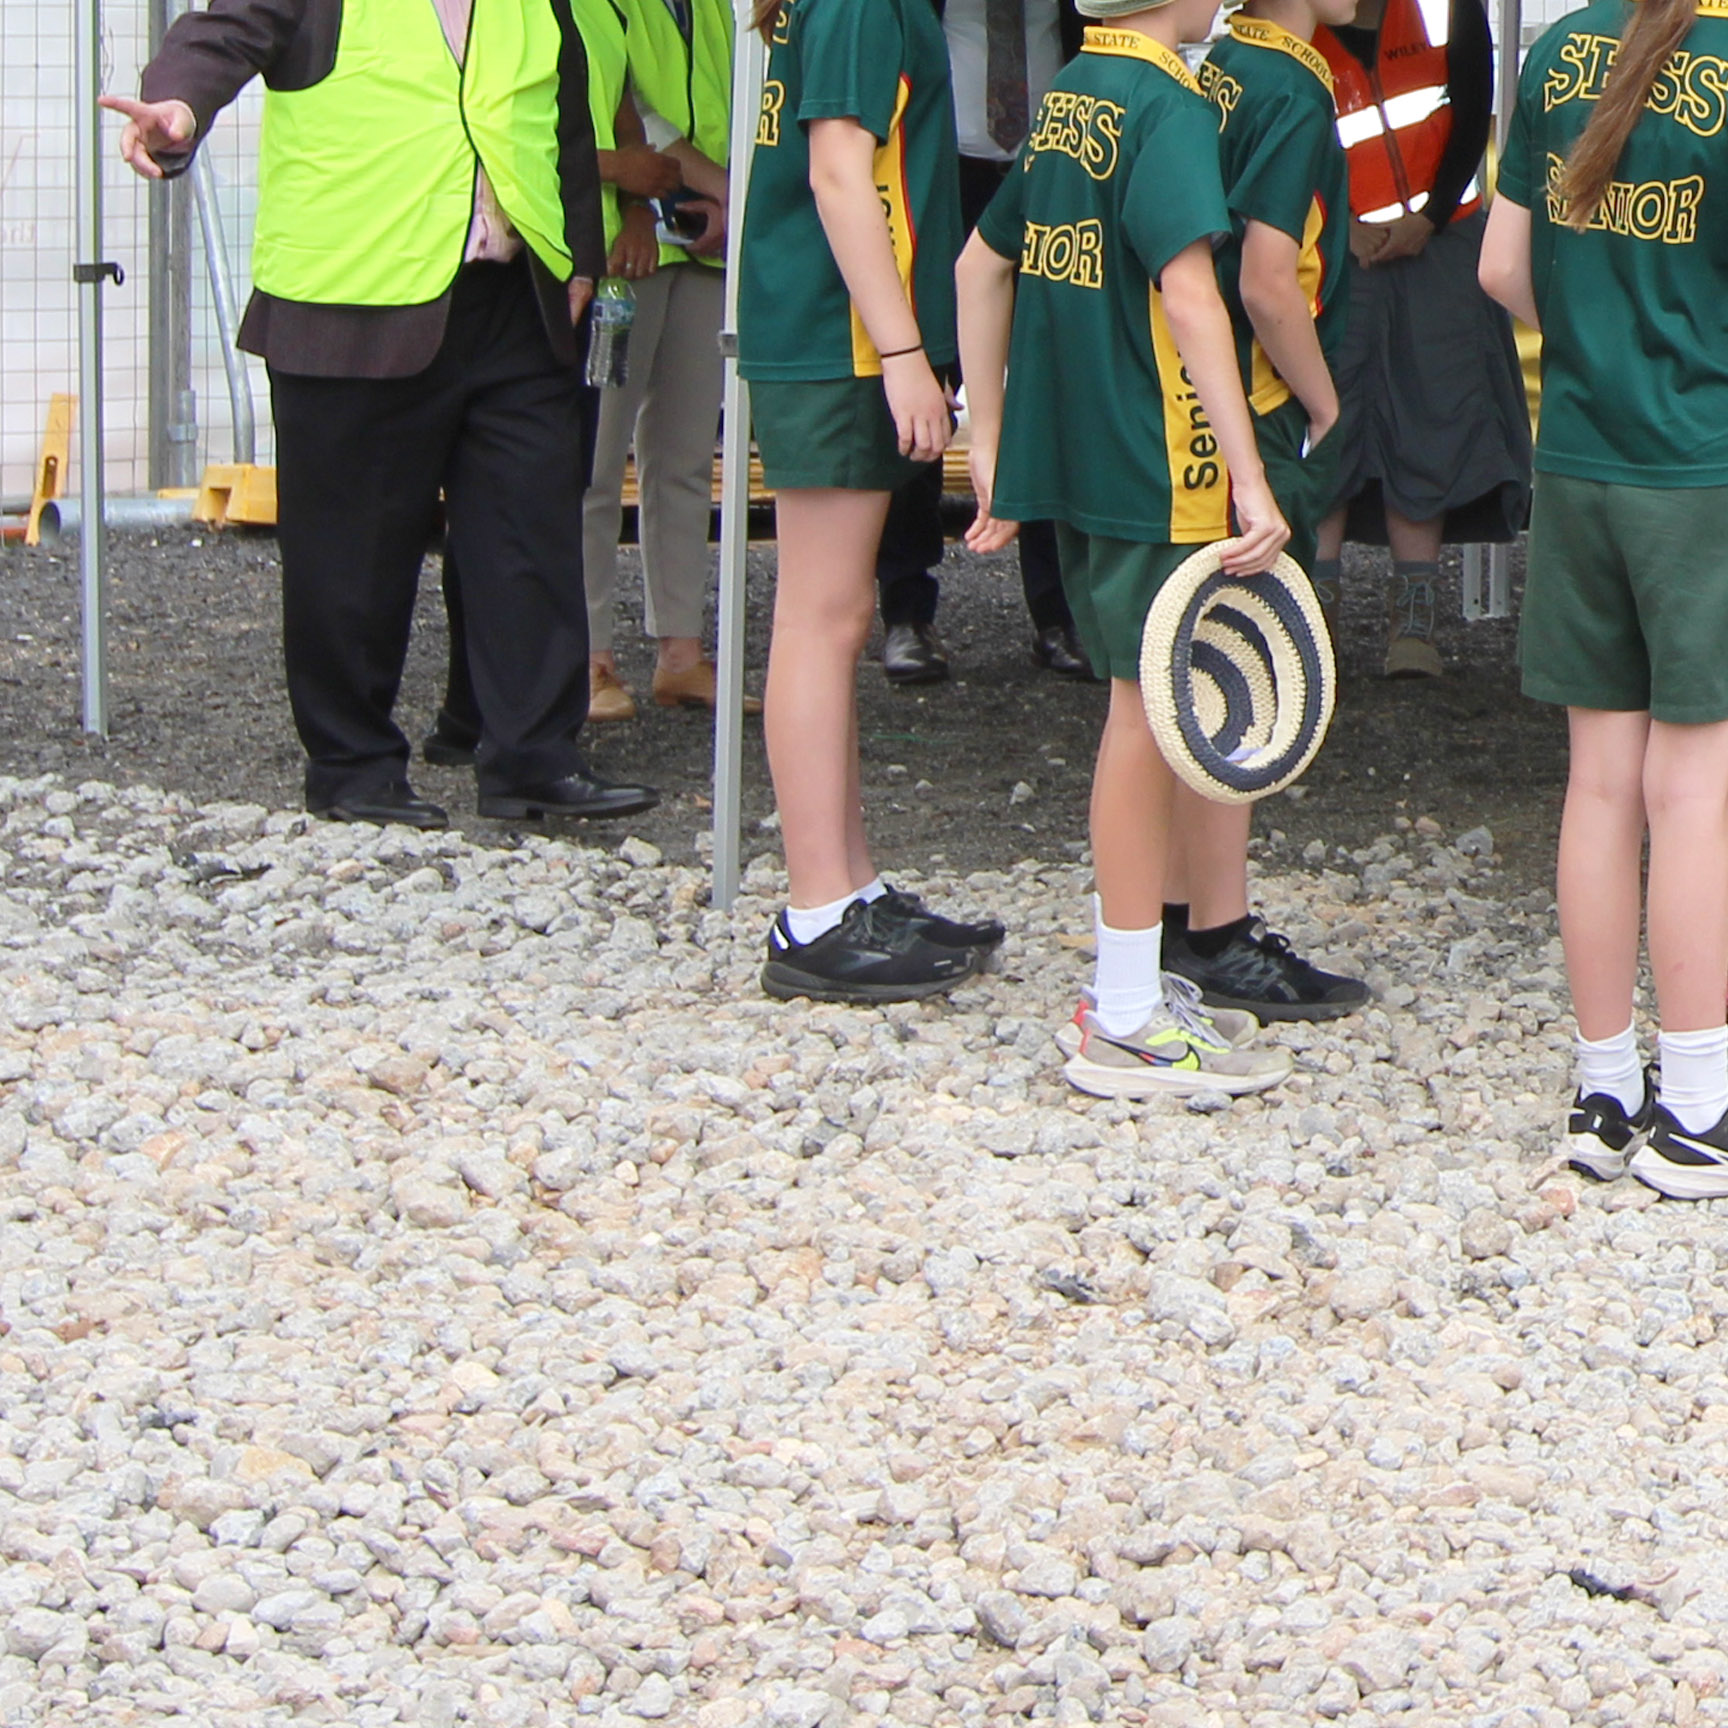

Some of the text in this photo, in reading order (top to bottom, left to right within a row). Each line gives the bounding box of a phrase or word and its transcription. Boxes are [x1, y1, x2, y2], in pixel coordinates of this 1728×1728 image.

[1093, 32, 1140, 49] STATE
[1281, 36, 1331, 82] SCHOOL
[1384, 41, 1428, 61] WILEY
